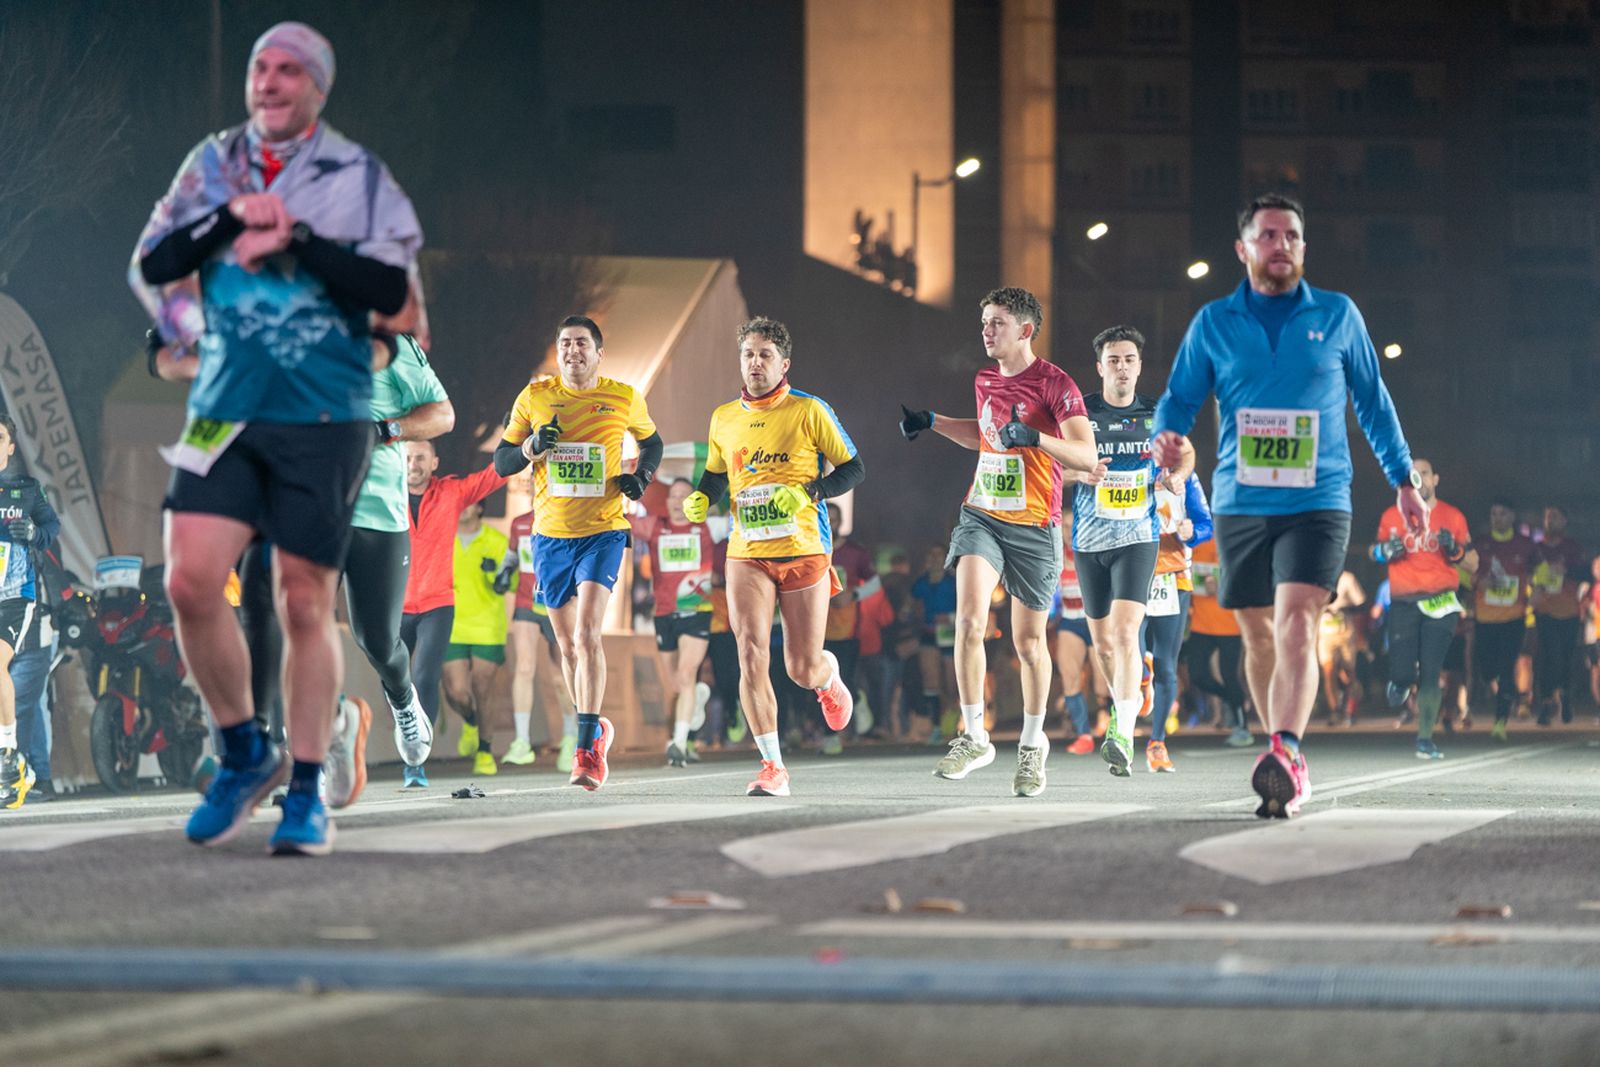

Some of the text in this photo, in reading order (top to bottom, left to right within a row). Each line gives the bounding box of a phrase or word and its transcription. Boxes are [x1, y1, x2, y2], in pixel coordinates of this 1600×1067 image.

[20, 331, 92, 506] JAPEMASA
[751, 446, 789, 464] Álora
[1097, 438, 1151, 455] AN ANTÓ
[1253, 437, 1301, 461] 7287
[558, 462, 594, 479] 5212
[1108, 488, 1138, 503] 1449
[0, 505, 23, 518] TÓN
[1149, 588, 1168, 600] 26
